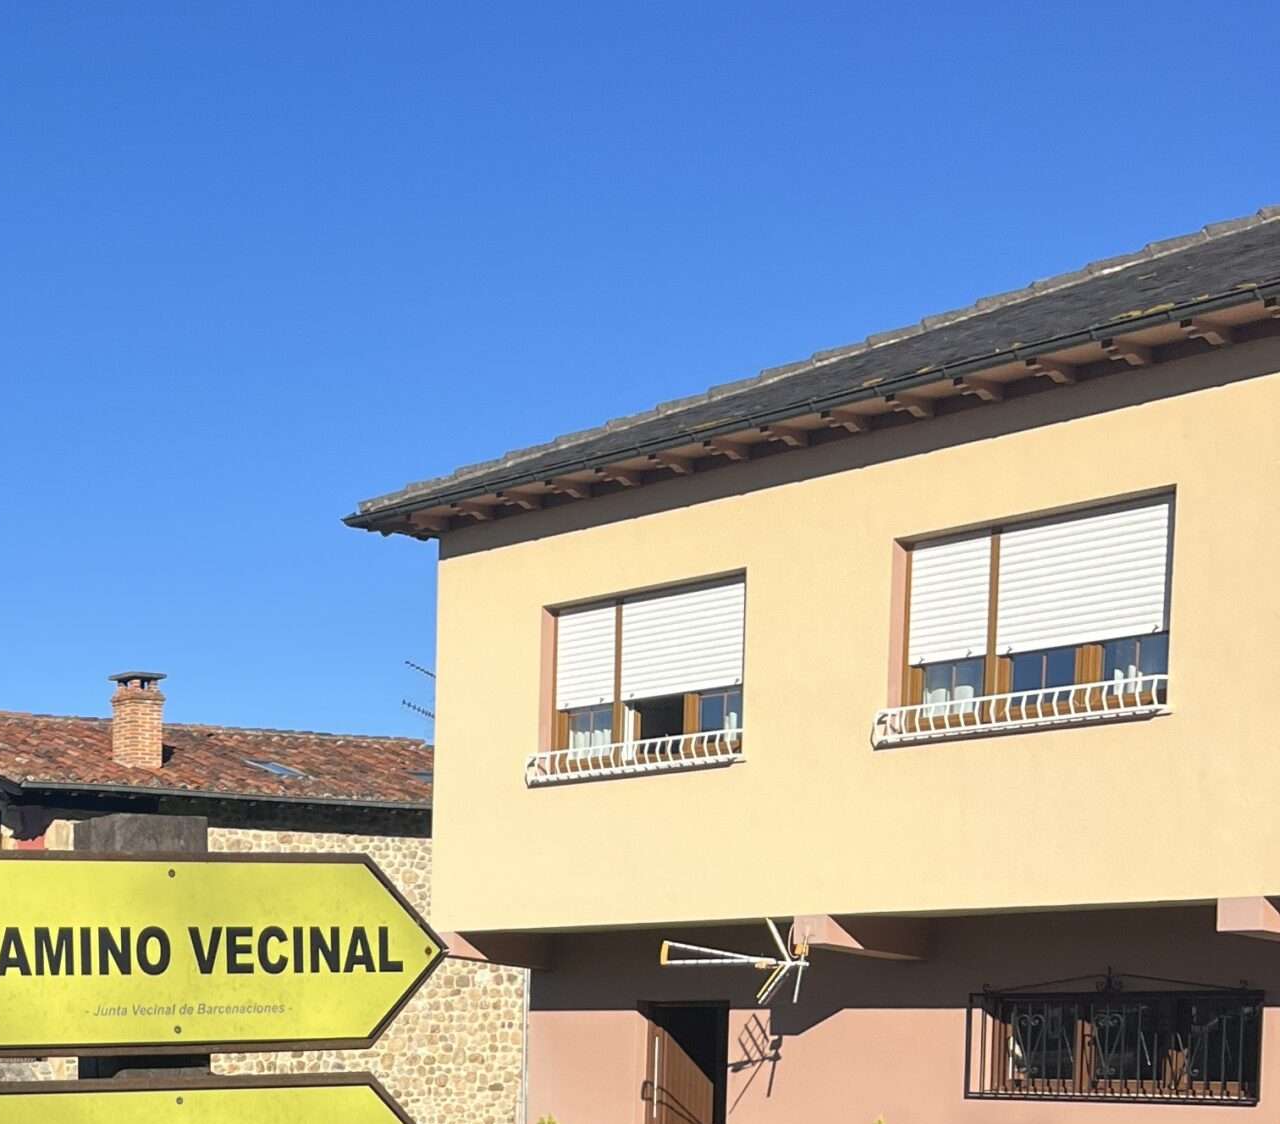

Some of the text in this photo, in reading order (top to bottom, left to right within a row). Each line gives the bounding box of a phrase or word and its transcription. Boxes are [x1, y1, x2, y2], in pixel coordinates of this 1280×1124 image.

[189, 925, 404, 975] VECINAL
[94, 1003, 128, 1017] Junta
[132, 1003, 176, 1016] Vecinal
[178, 1003, 194, 1016] de
[197, 1002, 286, 1015] Barcenaciones
